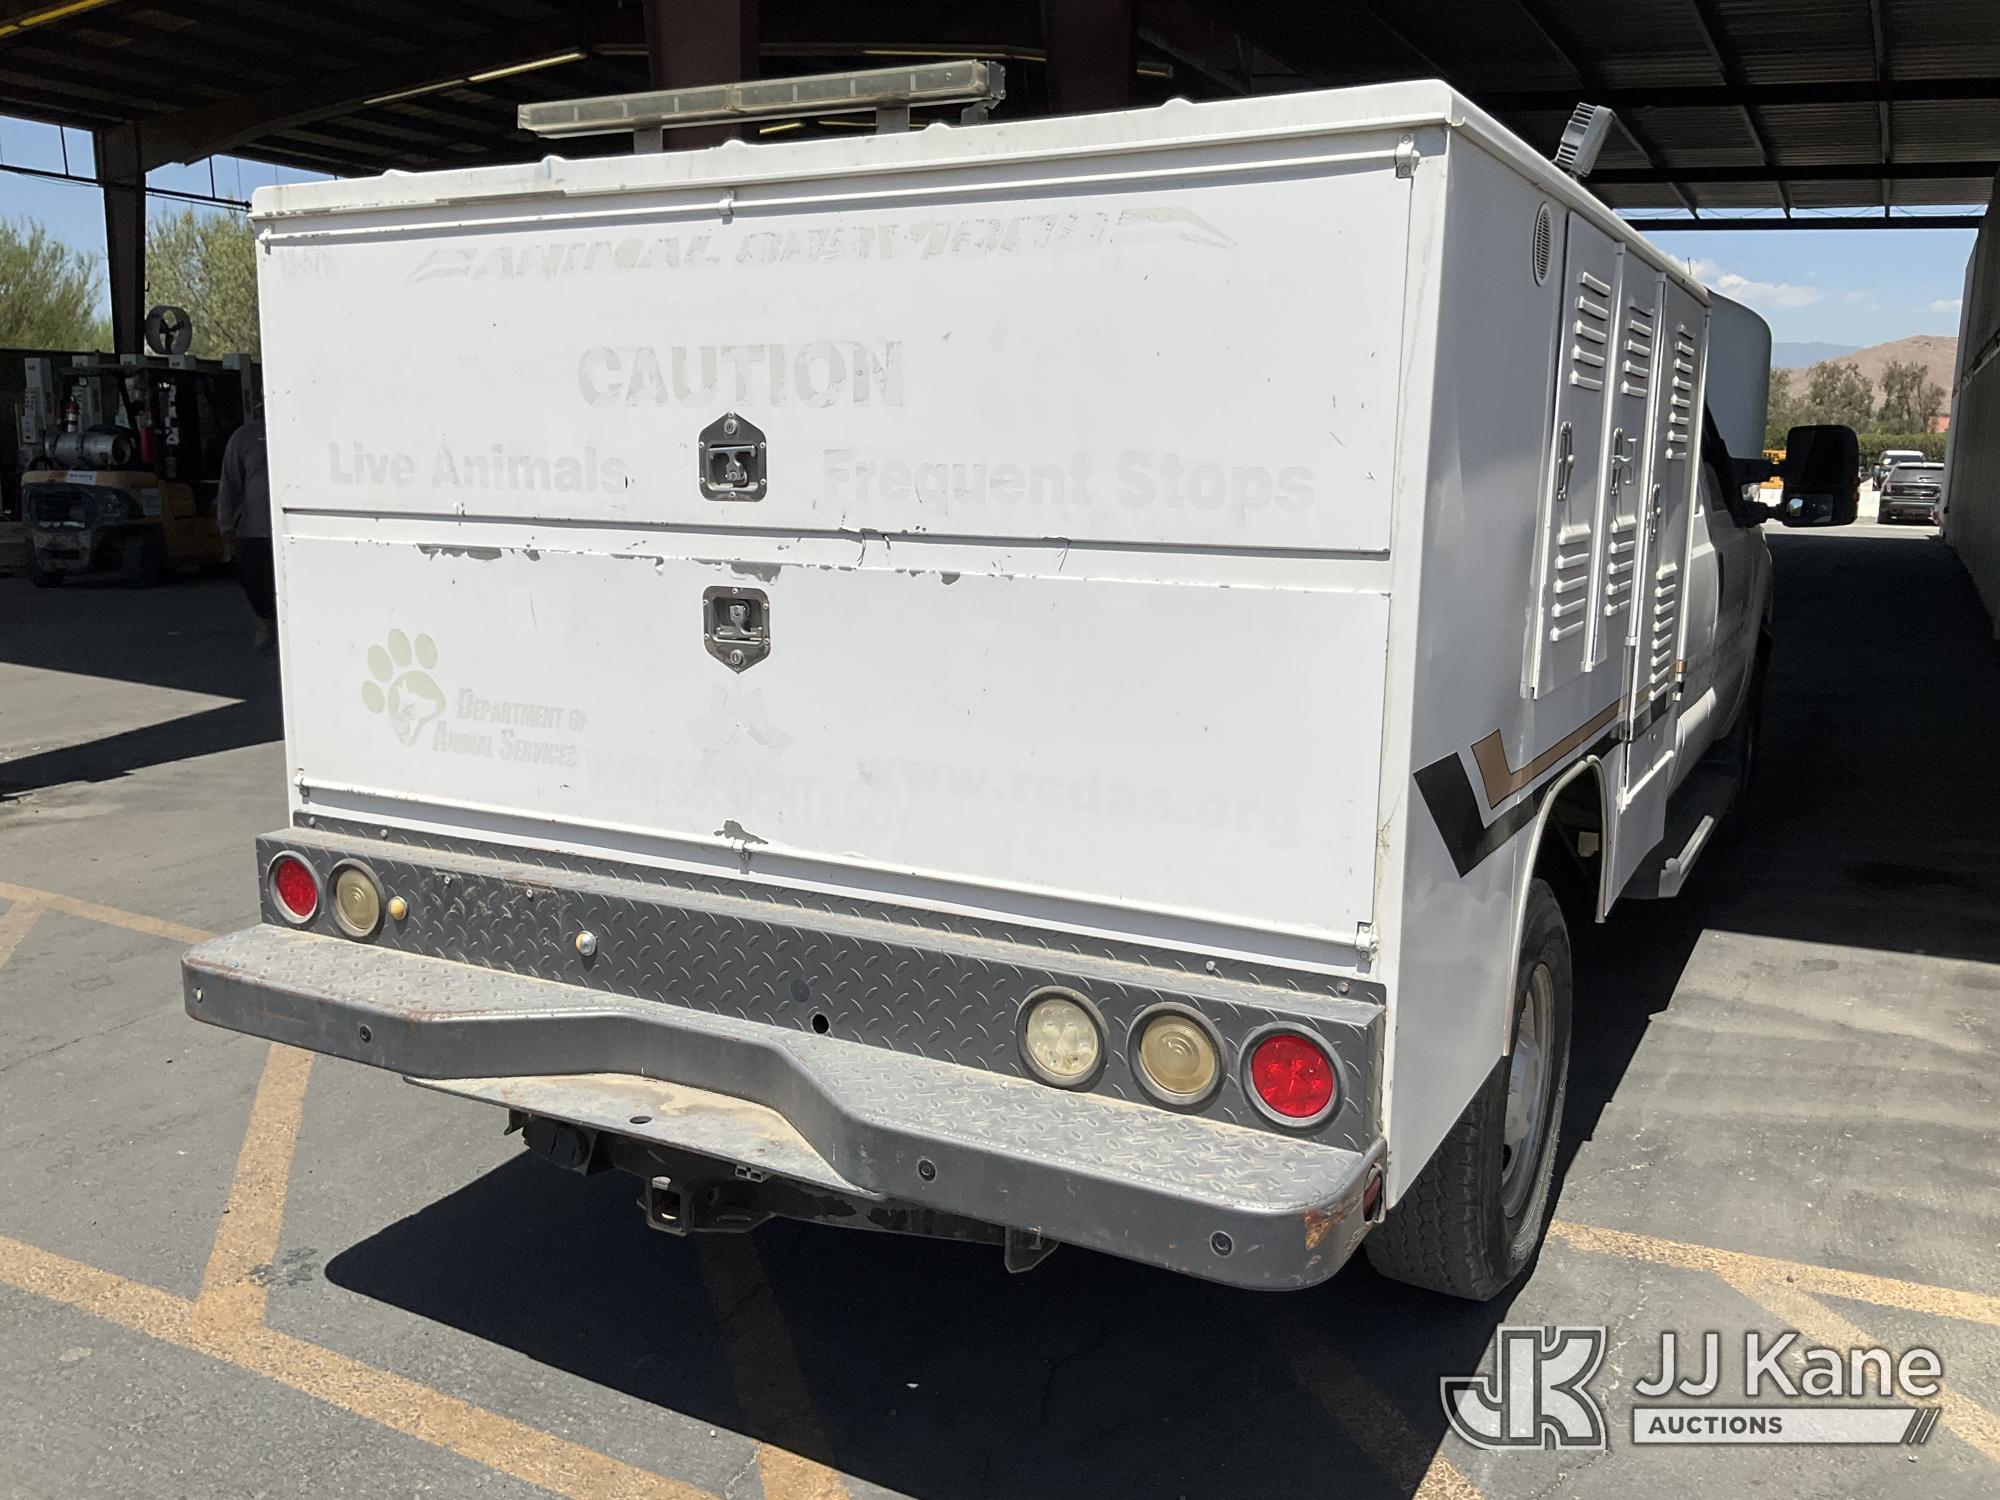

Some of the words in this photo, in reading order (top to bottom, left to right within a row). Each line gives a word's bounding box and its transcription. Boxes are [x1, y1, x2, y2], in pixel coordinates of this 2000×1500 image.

[578, 340, 904, 408] CAUTION
[328, 441, 415, 486] Live
[431, 443, 628, 494] Animals
[823, 448, 1094, 517] Frequent
[1115, 450, 1315, 526] Stops
